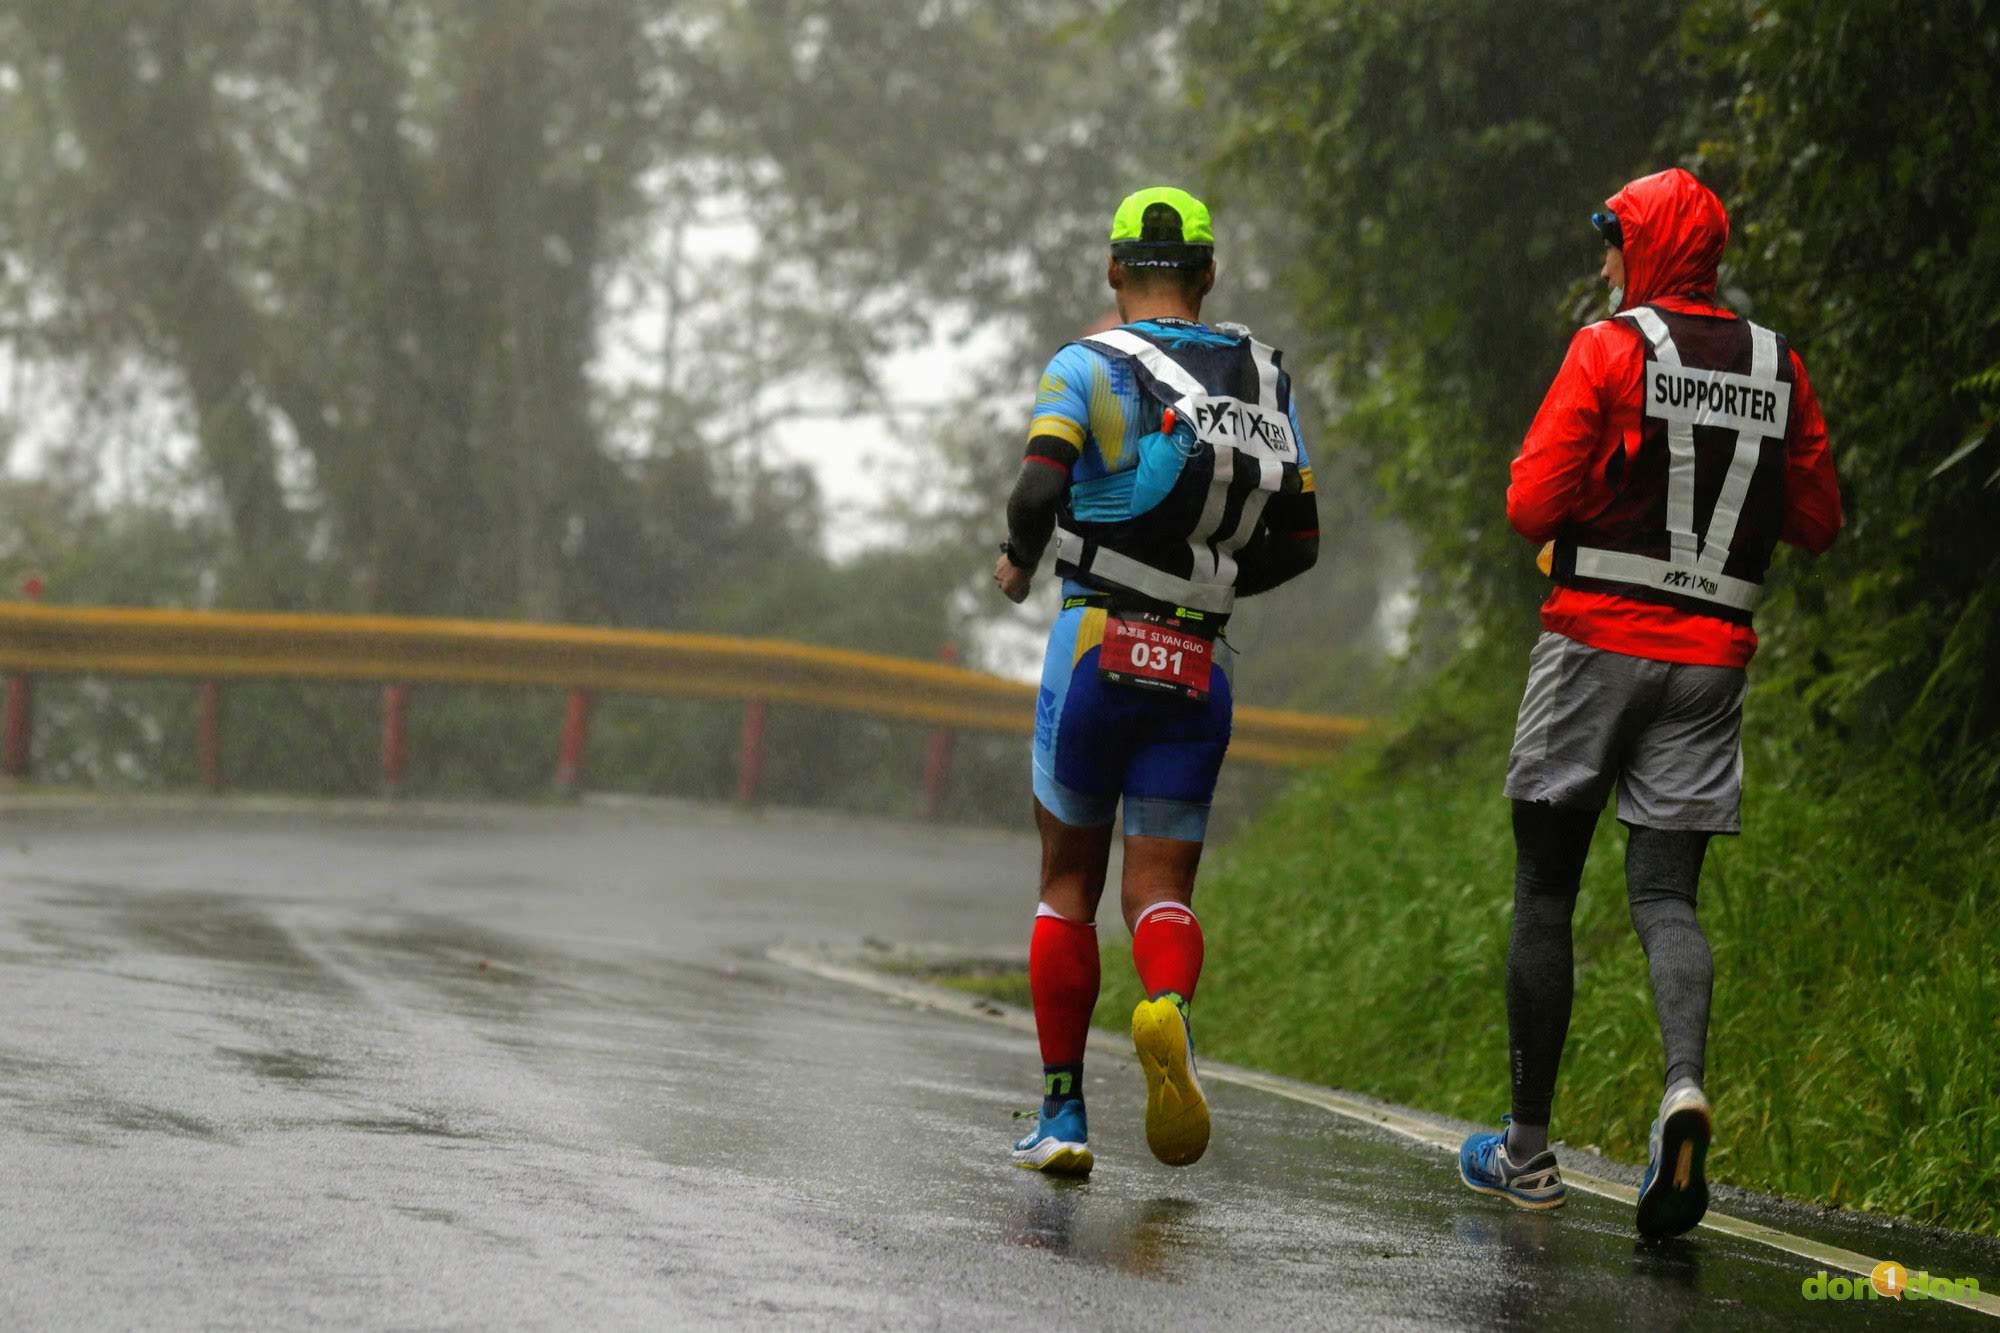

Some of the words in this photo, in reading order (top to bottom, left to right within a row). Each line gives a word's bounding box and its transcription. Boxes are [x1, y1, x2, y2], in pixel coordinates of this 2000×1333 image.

[1655, 373, 1776, 423] SUPPORTER
[1131, 642, 1183, 675] 031
[1151, 632, 1160, 642] SI
[1161, 635, 1181, 647] YAN
[1182, 640, 1204, 654] GUO
